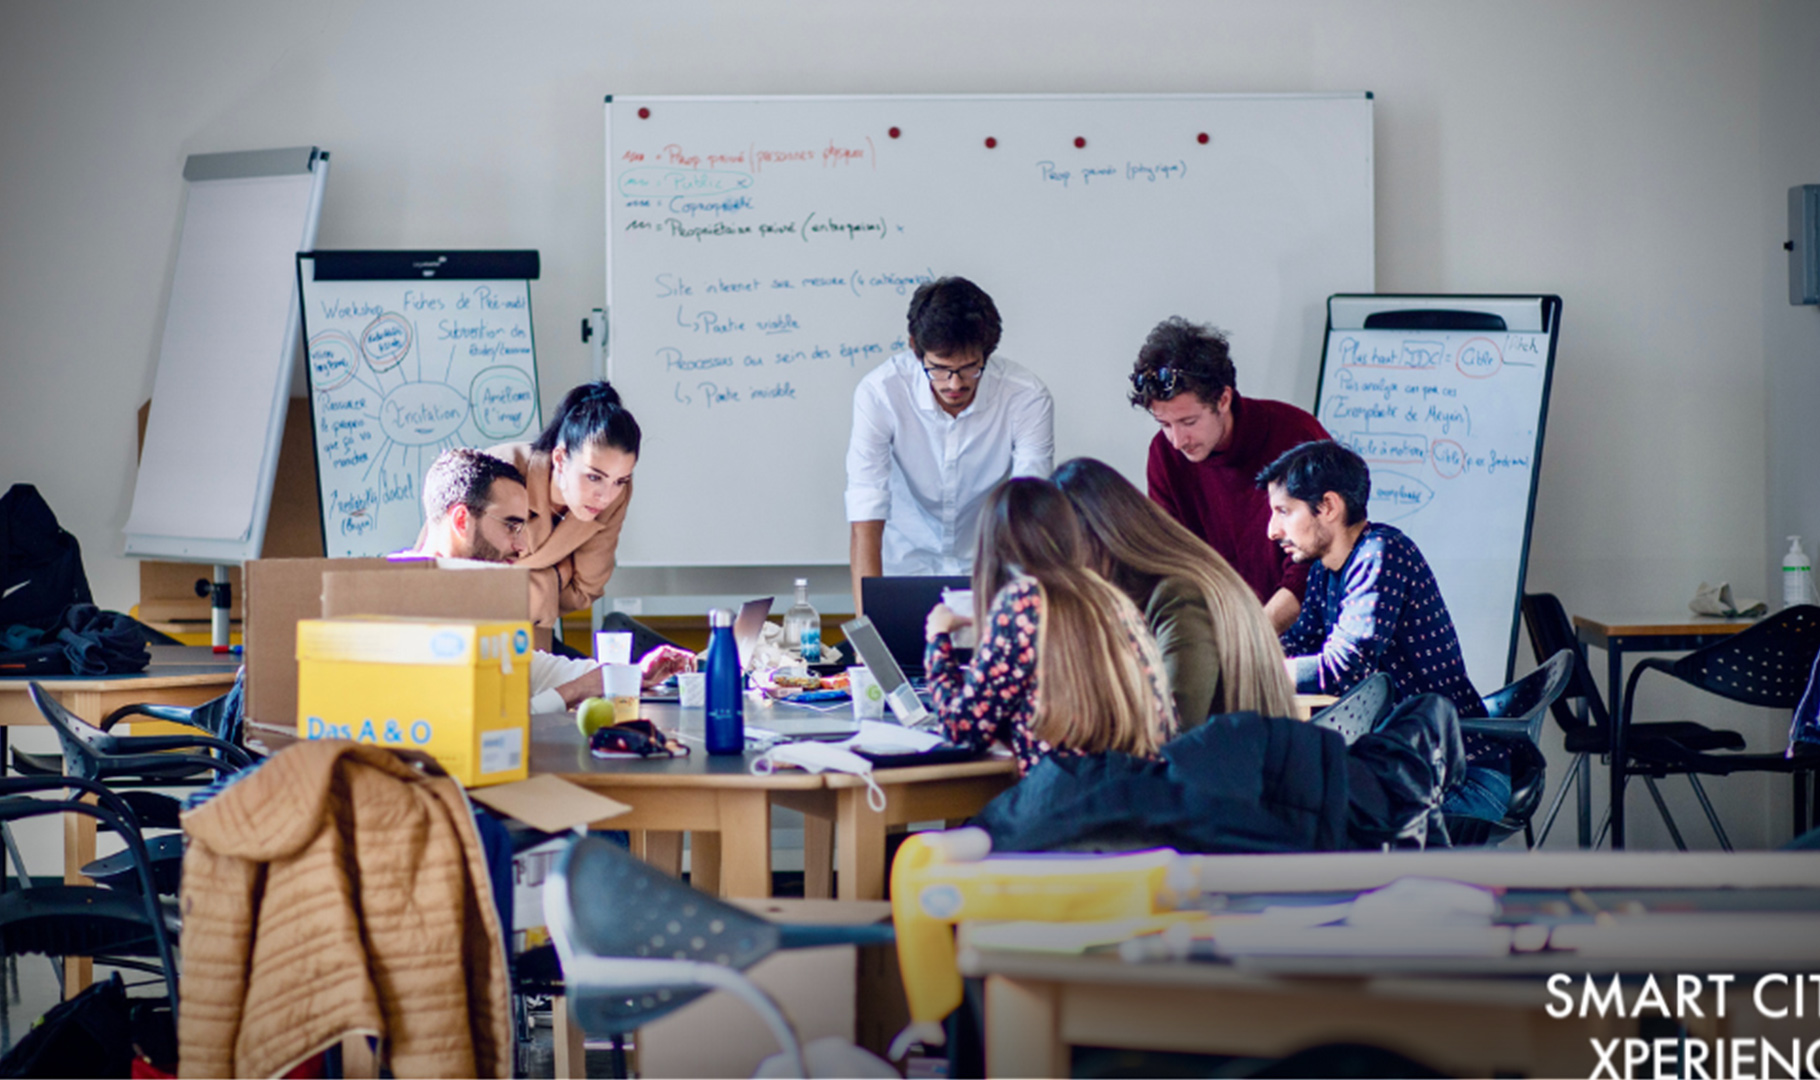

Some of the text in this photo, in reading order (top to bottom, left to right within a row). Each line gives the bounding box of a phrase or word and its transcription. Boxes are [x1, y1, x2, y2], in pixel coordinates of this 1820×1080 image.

[655, 273, 693, 298] Site
[307, 716, 432, 745] Das A & O
